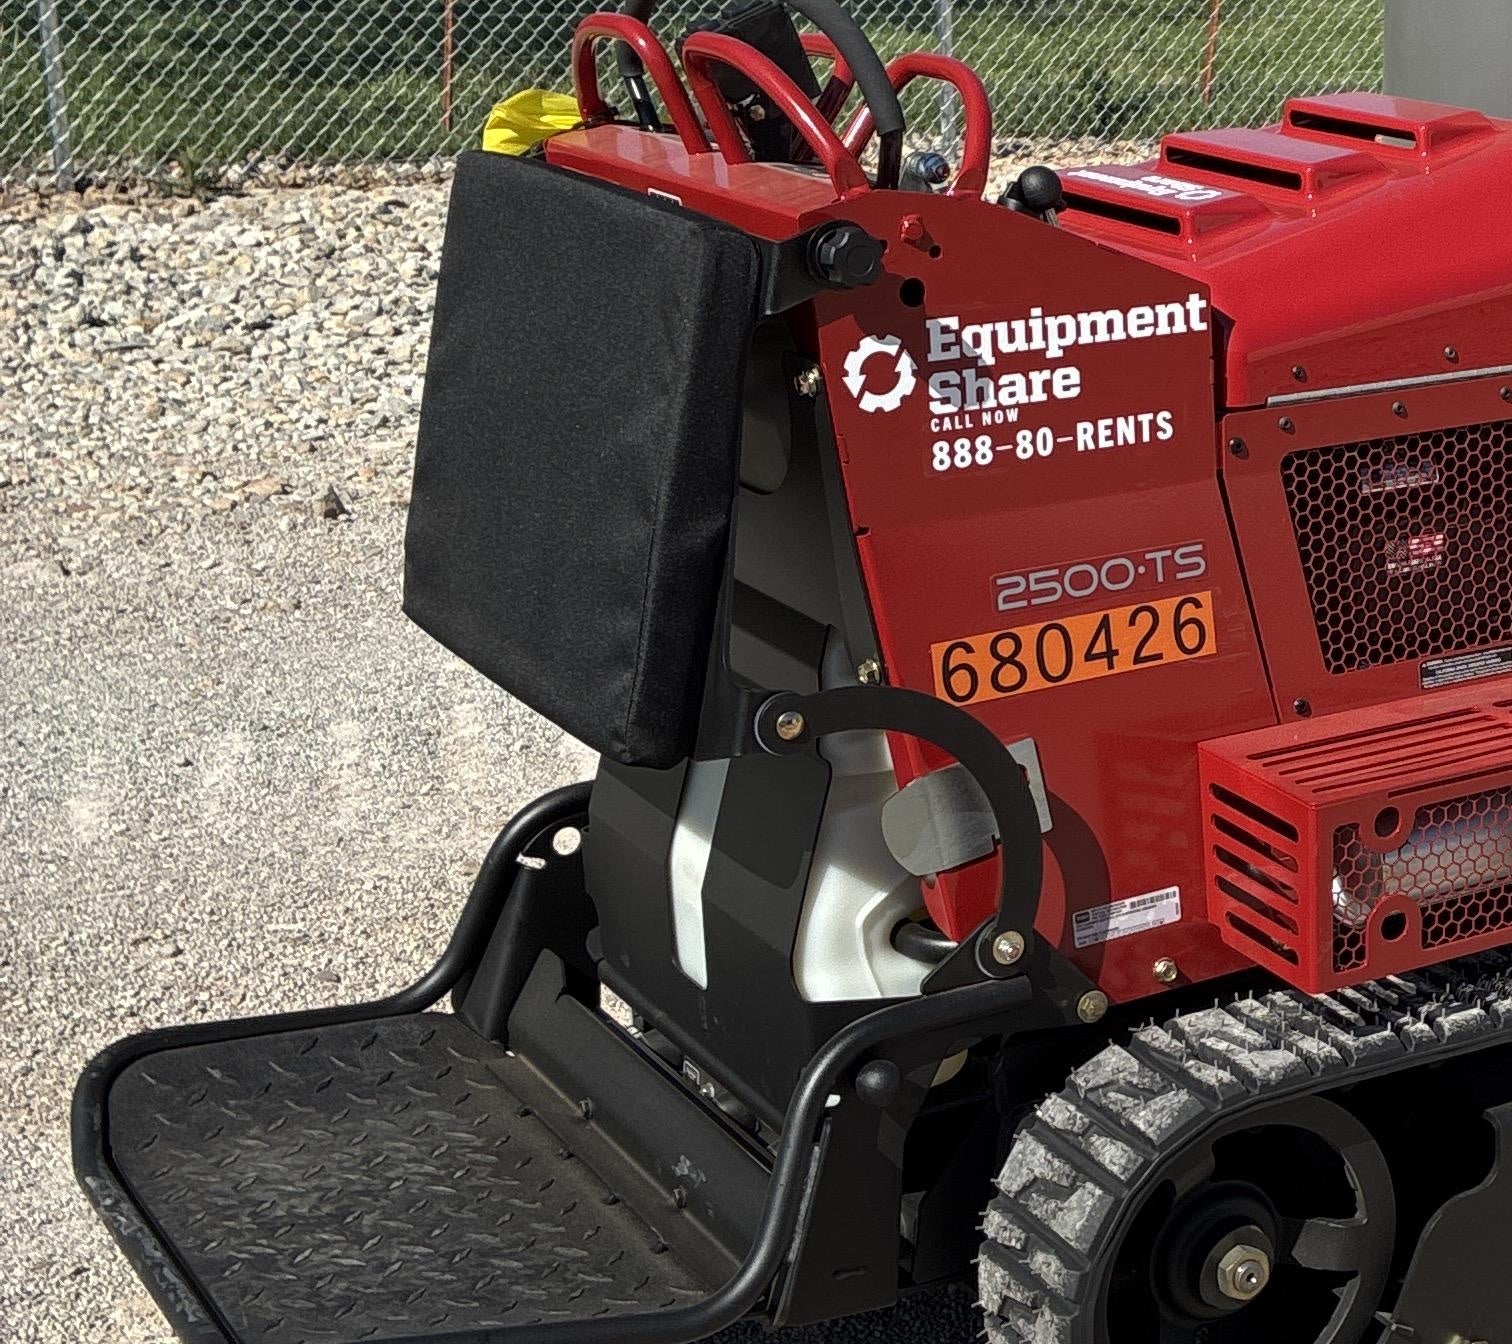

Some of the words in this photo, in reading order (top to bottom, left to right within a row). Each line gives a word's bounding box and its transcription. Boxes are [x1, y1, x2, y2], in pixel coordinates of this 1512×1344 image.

[926, 293, 1207, 366] Equipment
[928, 365, 1081, 415] Share
[930, 413, 973, 432] CALL
[982, 408, 1019, 426] NOW
[932, 410, 1174, 471] 888-80-RENTS
[943, 596, 1206, 703] 680426
